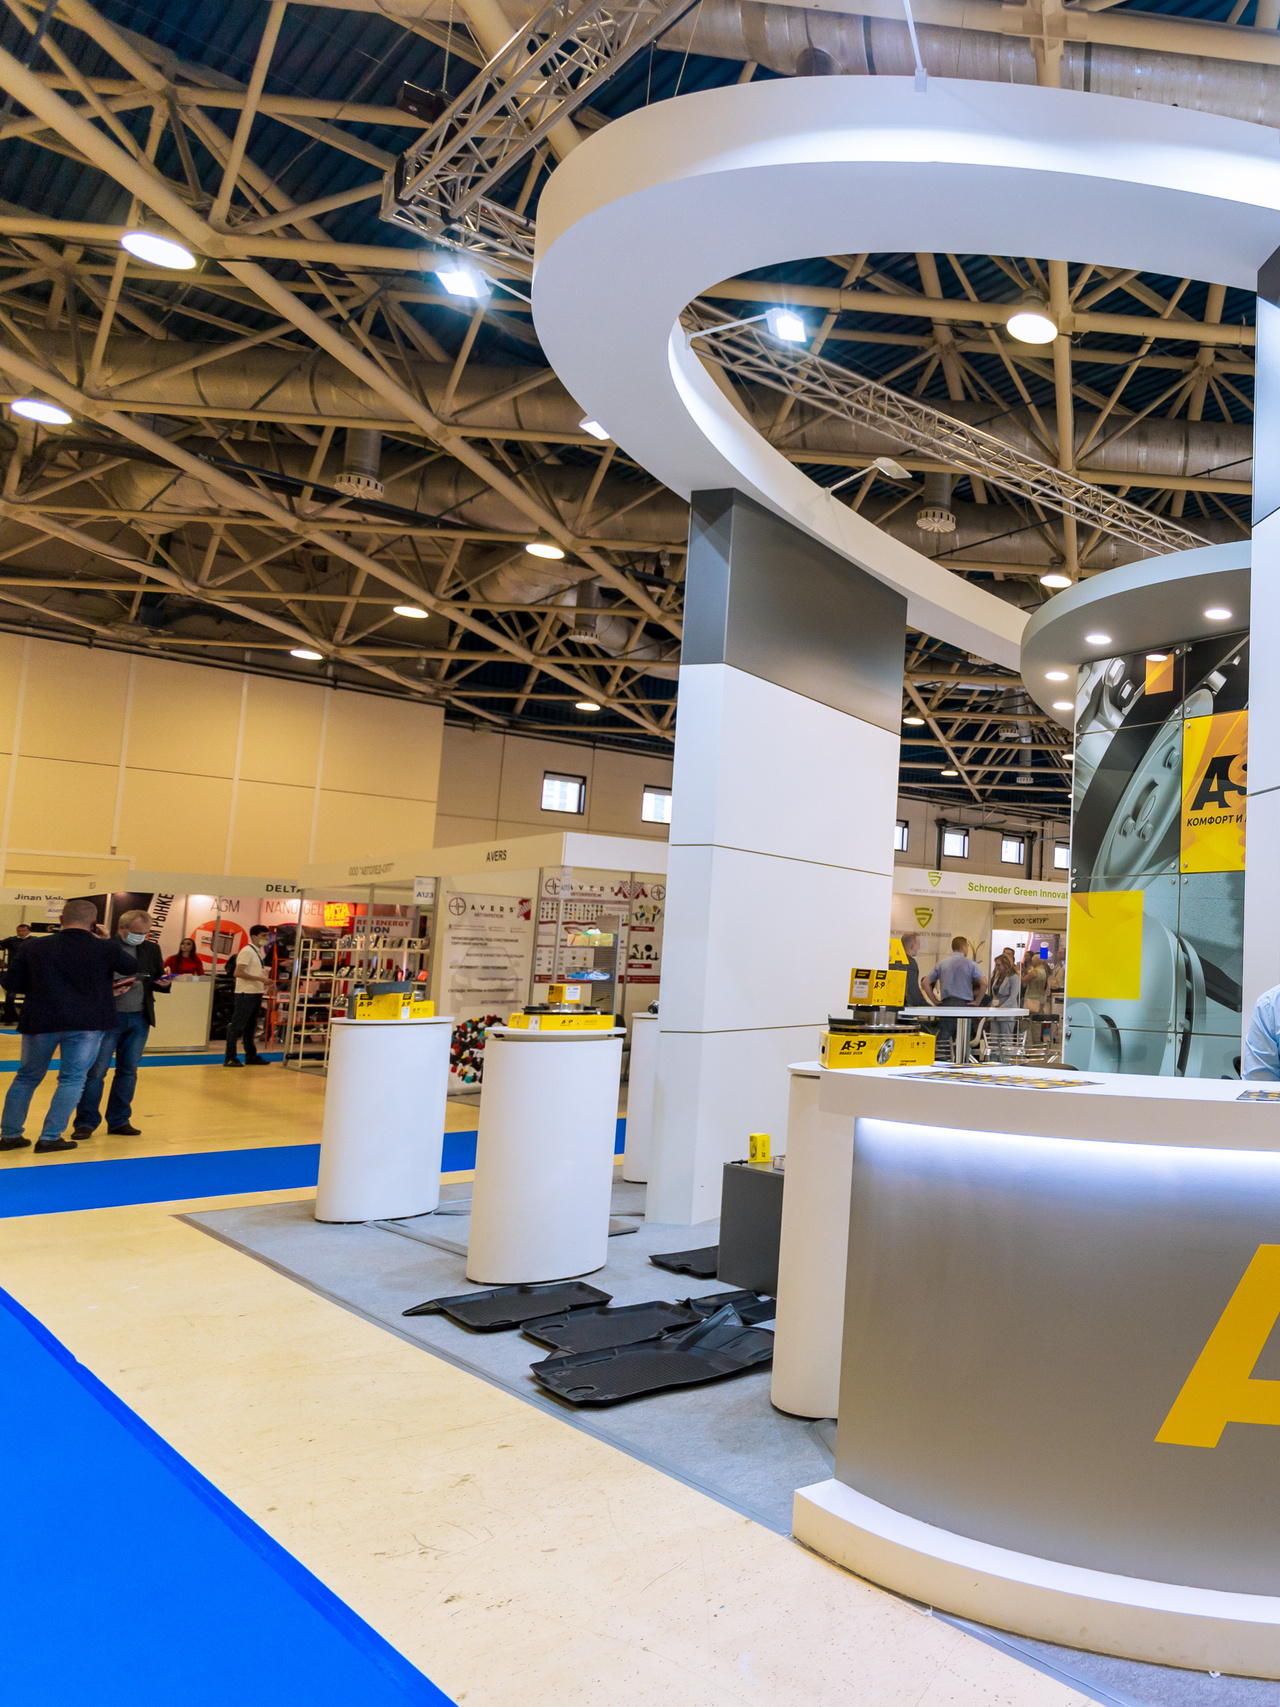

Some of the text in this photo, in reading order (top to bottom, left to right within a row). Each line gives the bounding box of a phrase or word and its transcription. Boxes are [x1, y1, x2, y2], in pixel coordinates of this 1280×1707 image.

[1187, 814, 1243, 827] КОМФОРТ И
[486, 849, 507, 862] AVERS
[968, 882, 1068, 900] Schroeder Green Innovat
[152, 893, 174, 927] РЫНКЕ
[210, 899, 240, 913] AGM
[265, 901, 299, 916] NANO
[303, 904, 323, 916] GEL
[470, 904, 514, 913] AVERS
[375, 919, 410, 927] ENERGY
[841, 1041, 866, 1050] ASP
